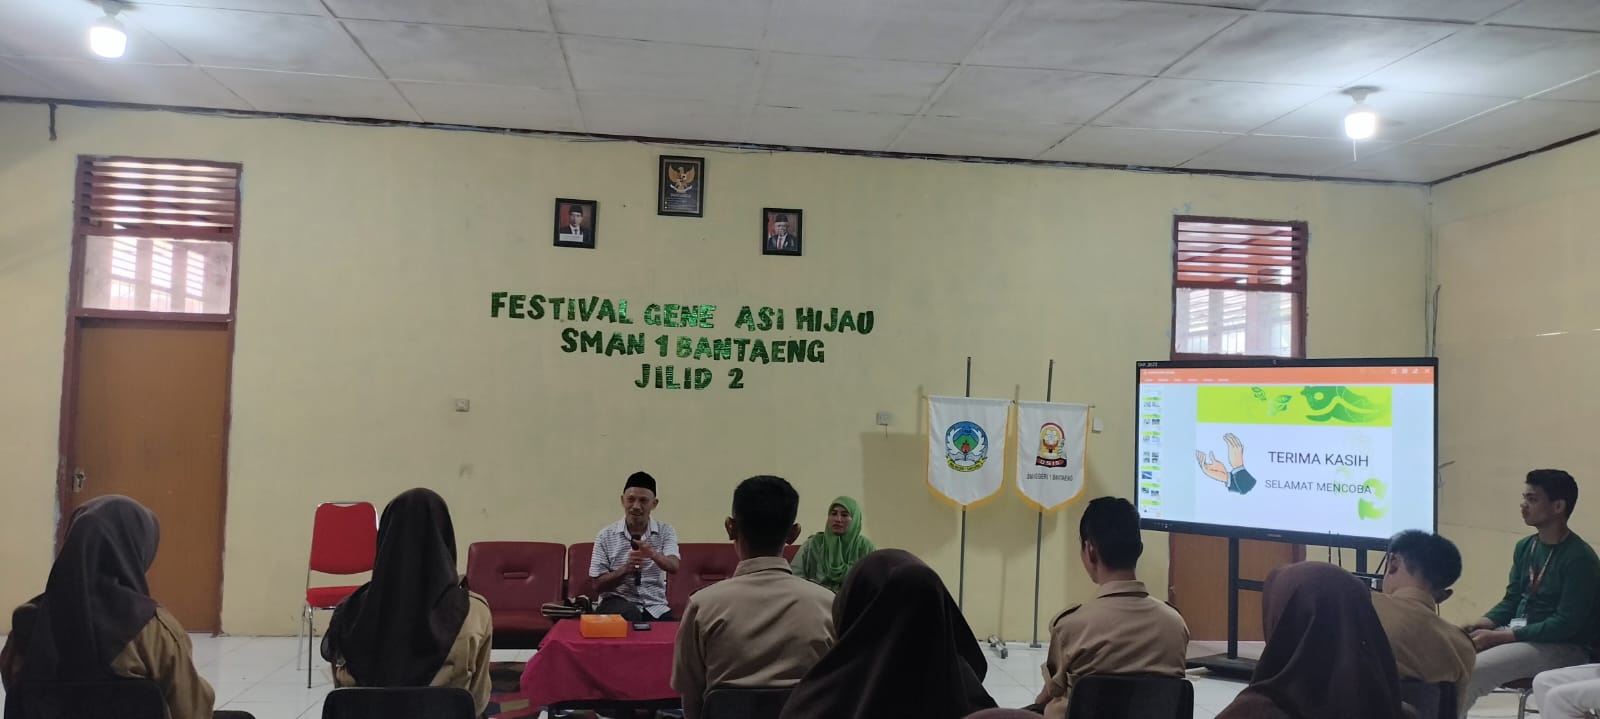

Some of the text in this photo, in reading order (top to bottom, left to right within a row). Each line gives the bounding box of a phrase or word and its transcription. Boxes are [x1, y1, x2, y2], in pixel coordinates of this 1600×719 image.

[491, 291, 875, 335] FESTIVAL GENE ASI HIJAU
[560, 328, 825, 364] SMAN 1 BANTAENG
[634, 364, 744, 390] JILID 2
[1268, 450, 1369, 467] TERIMA KASIH
[1265, 479, 1373, 495] SELAMAT MENCOBA
